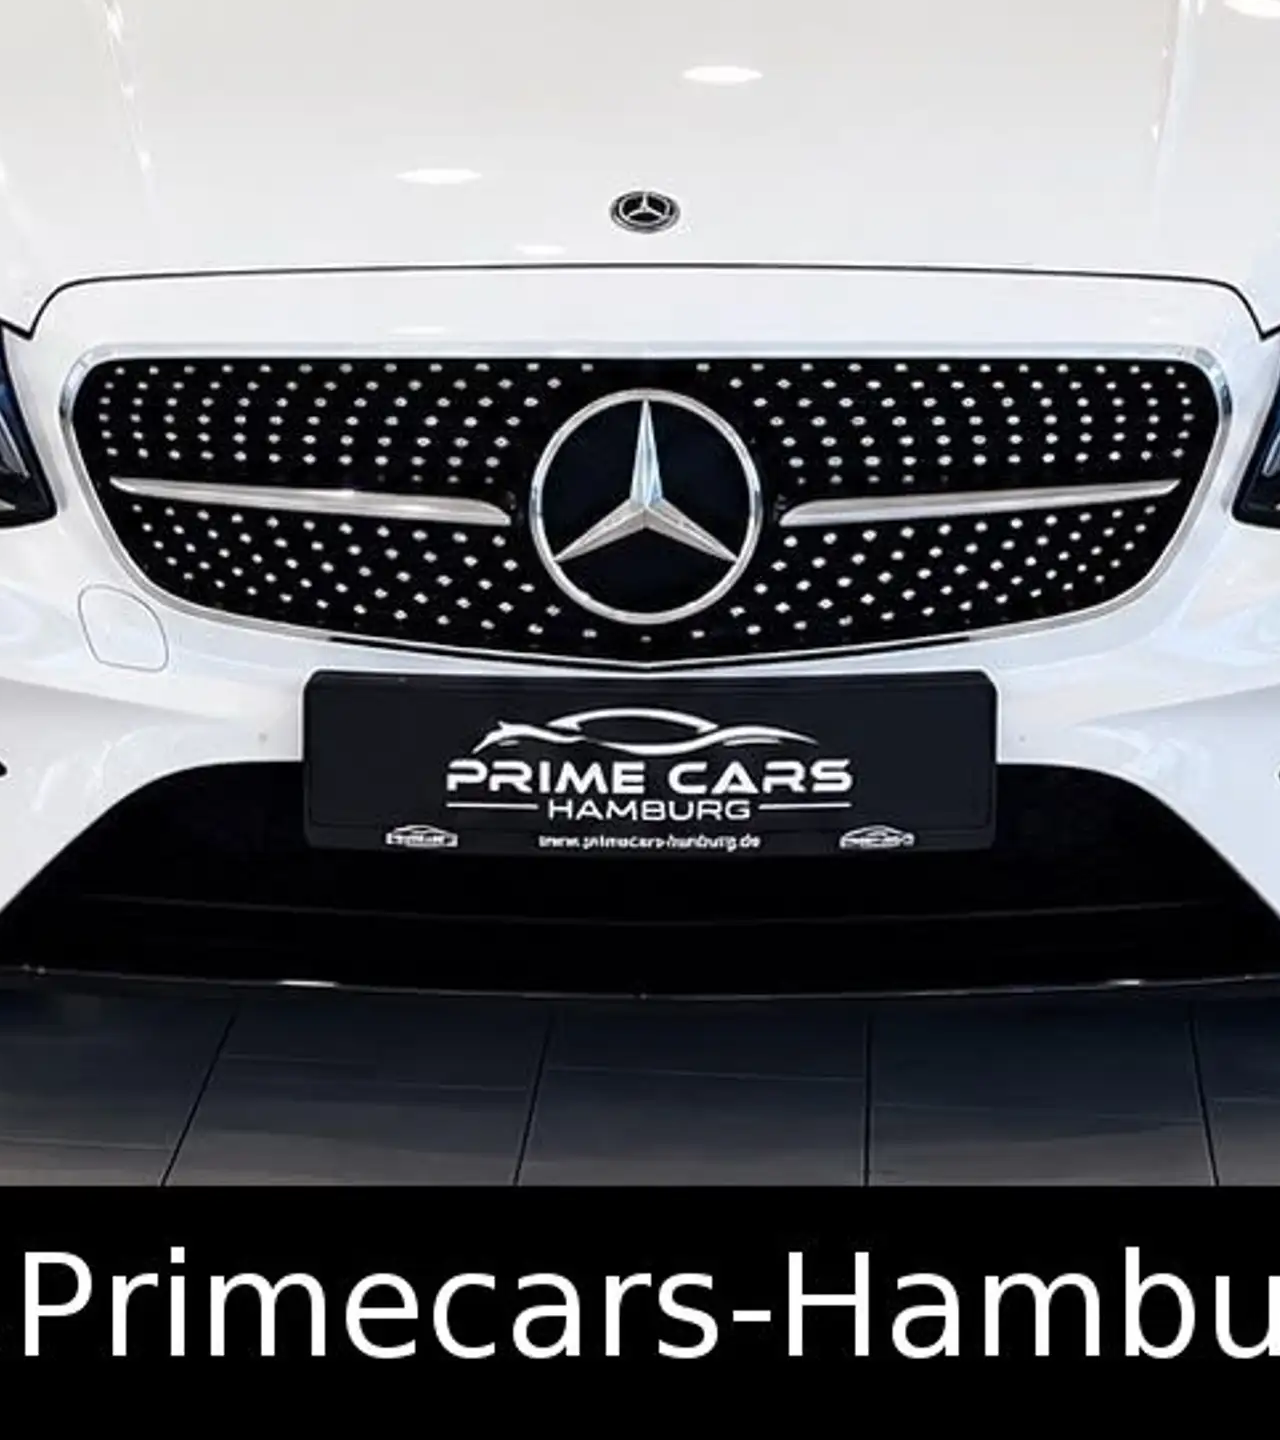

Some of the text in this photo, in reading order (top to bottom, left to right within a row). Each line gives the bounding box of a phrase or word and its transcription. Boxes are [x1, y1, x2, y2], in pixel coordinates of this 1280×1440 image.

[446, 760, 853, 794] PRIME CARS
[548, 799, 751, 821] HAMBURG
